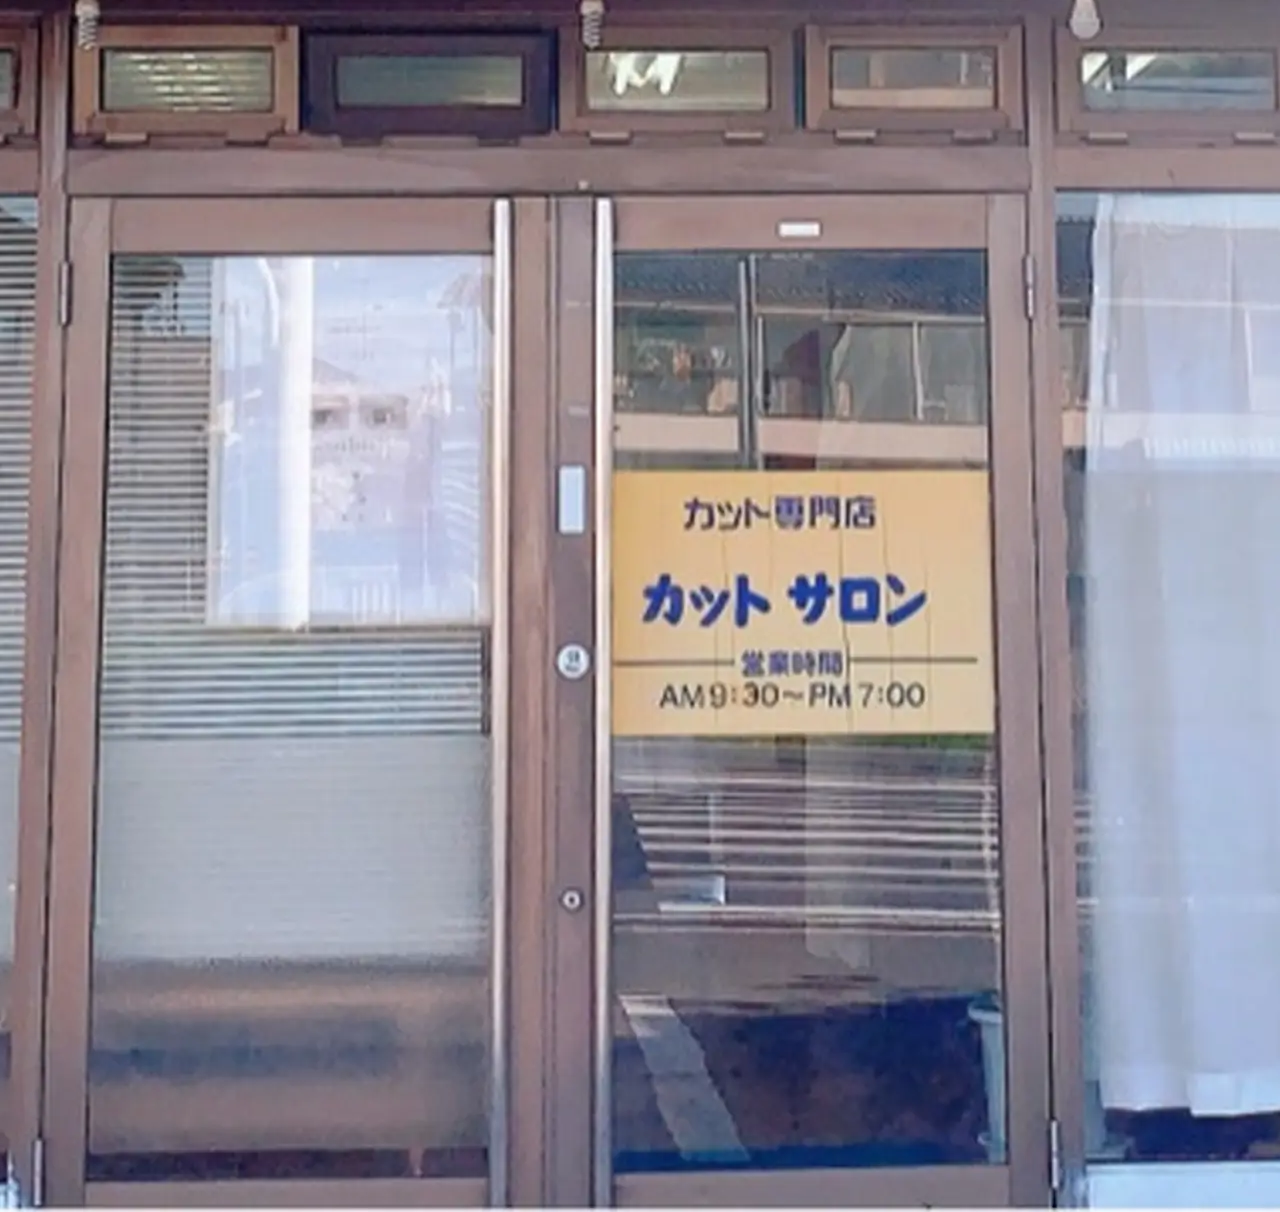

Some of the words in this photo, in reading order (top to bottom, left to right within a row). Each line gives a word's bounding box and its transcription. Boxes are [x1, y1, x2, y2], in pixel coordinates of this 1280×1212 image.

[684, 495, 877, 531] カット専門店
[642, 573, 772, 629] カット
[788, 572, 928, 627] サロン
